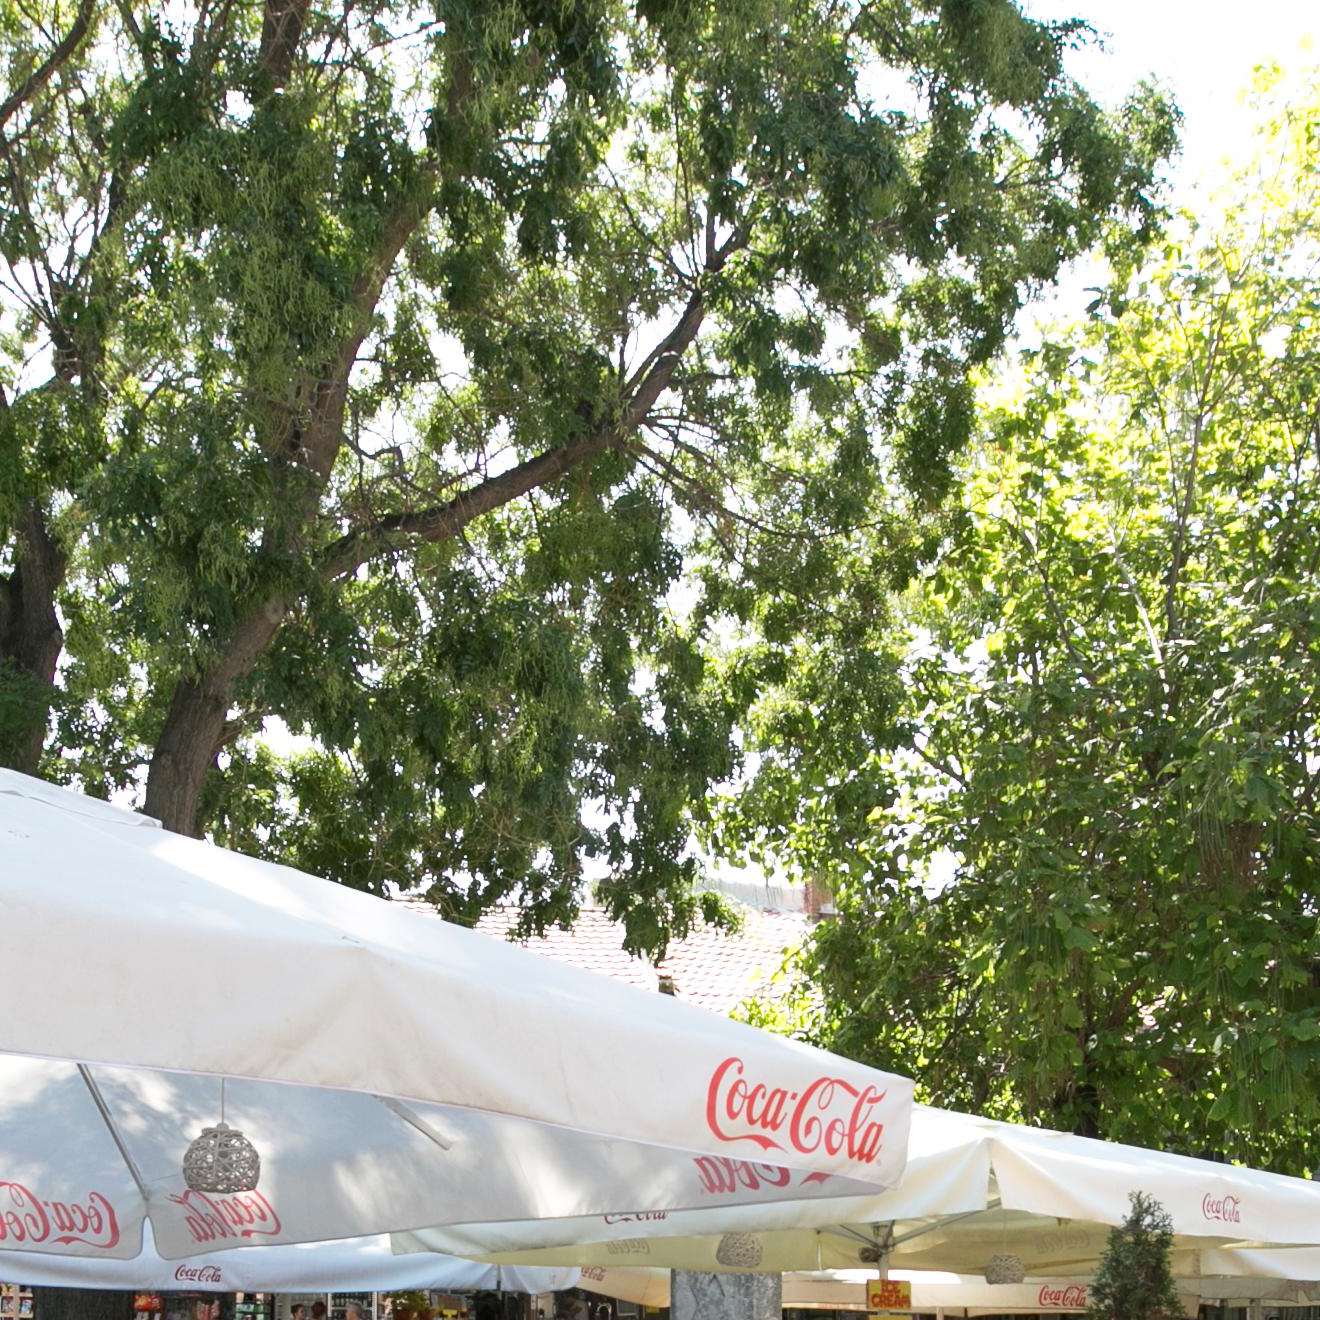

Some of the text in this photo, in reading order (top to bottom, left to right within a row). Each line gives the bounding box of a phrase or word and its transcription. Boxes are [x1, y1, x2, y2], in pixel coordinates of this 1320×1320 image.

[706, 1057, 888, 1164] Coca-Cola
[1202, 1192, 1241, 1223] Coca-Cola
[175, 1264, 222, 1282] Coca-Cola
[1039, 1284, 1087, 1307] Coca-Cola
